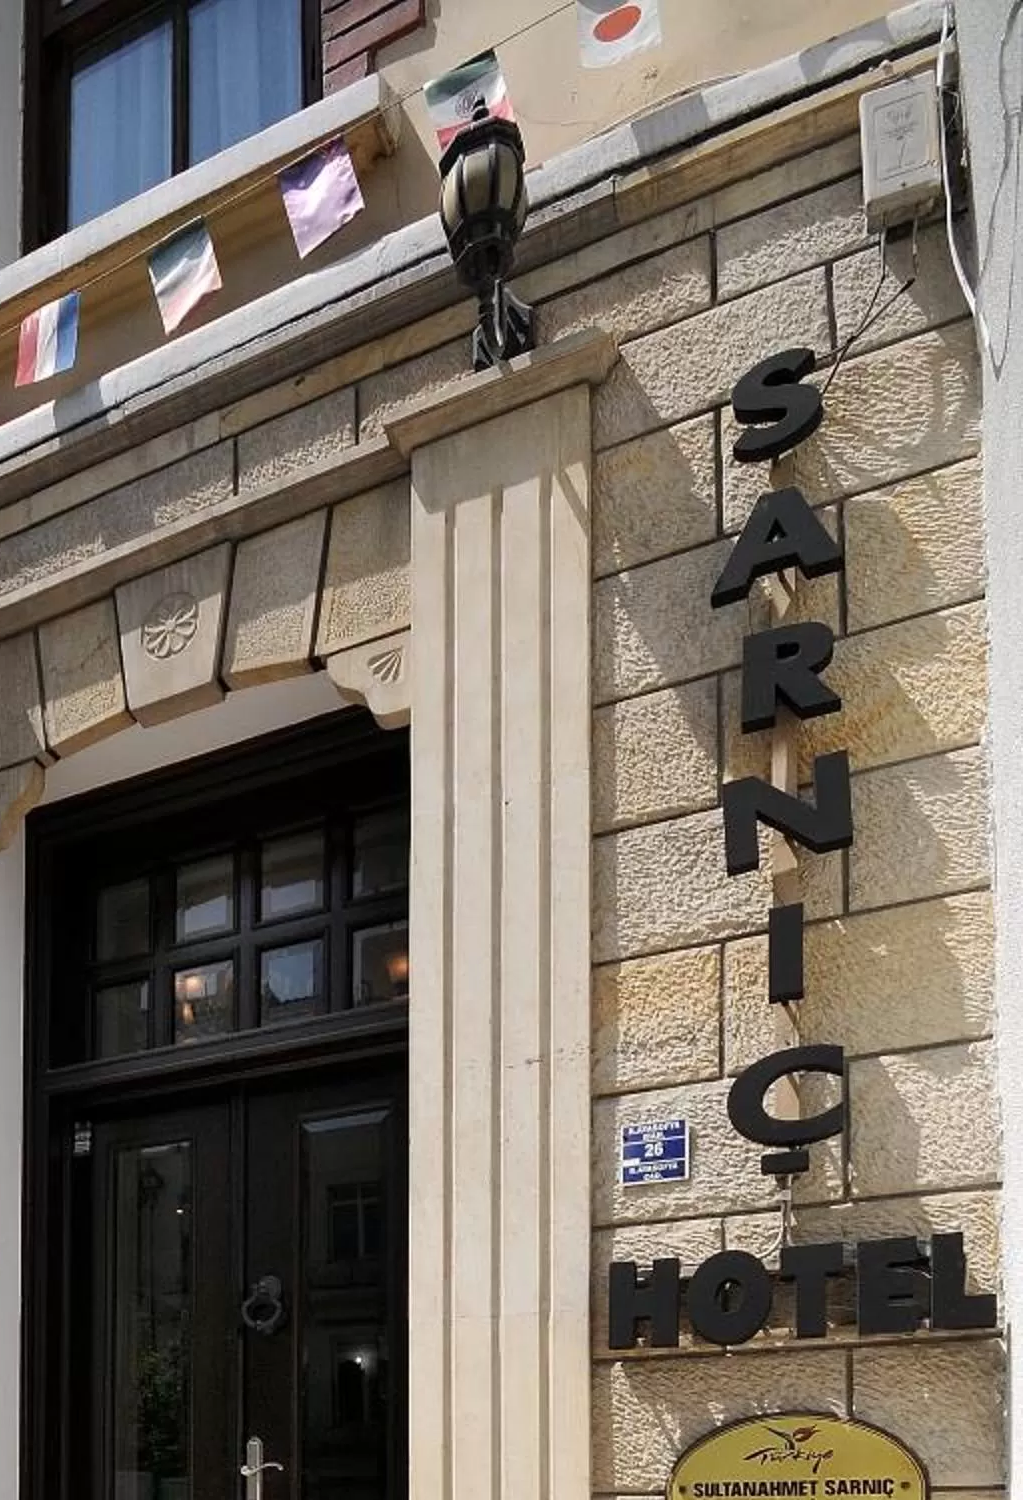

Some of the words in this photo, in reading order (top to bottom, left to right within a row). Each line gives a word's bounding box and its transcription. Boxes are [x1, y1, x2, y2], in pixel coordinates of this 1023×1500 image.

[644, 1141, 664, 1158] 26
[609, 1231, 997, 1350] HOTEL
[693, 1480, 818, 1498] SULTANAHMET
